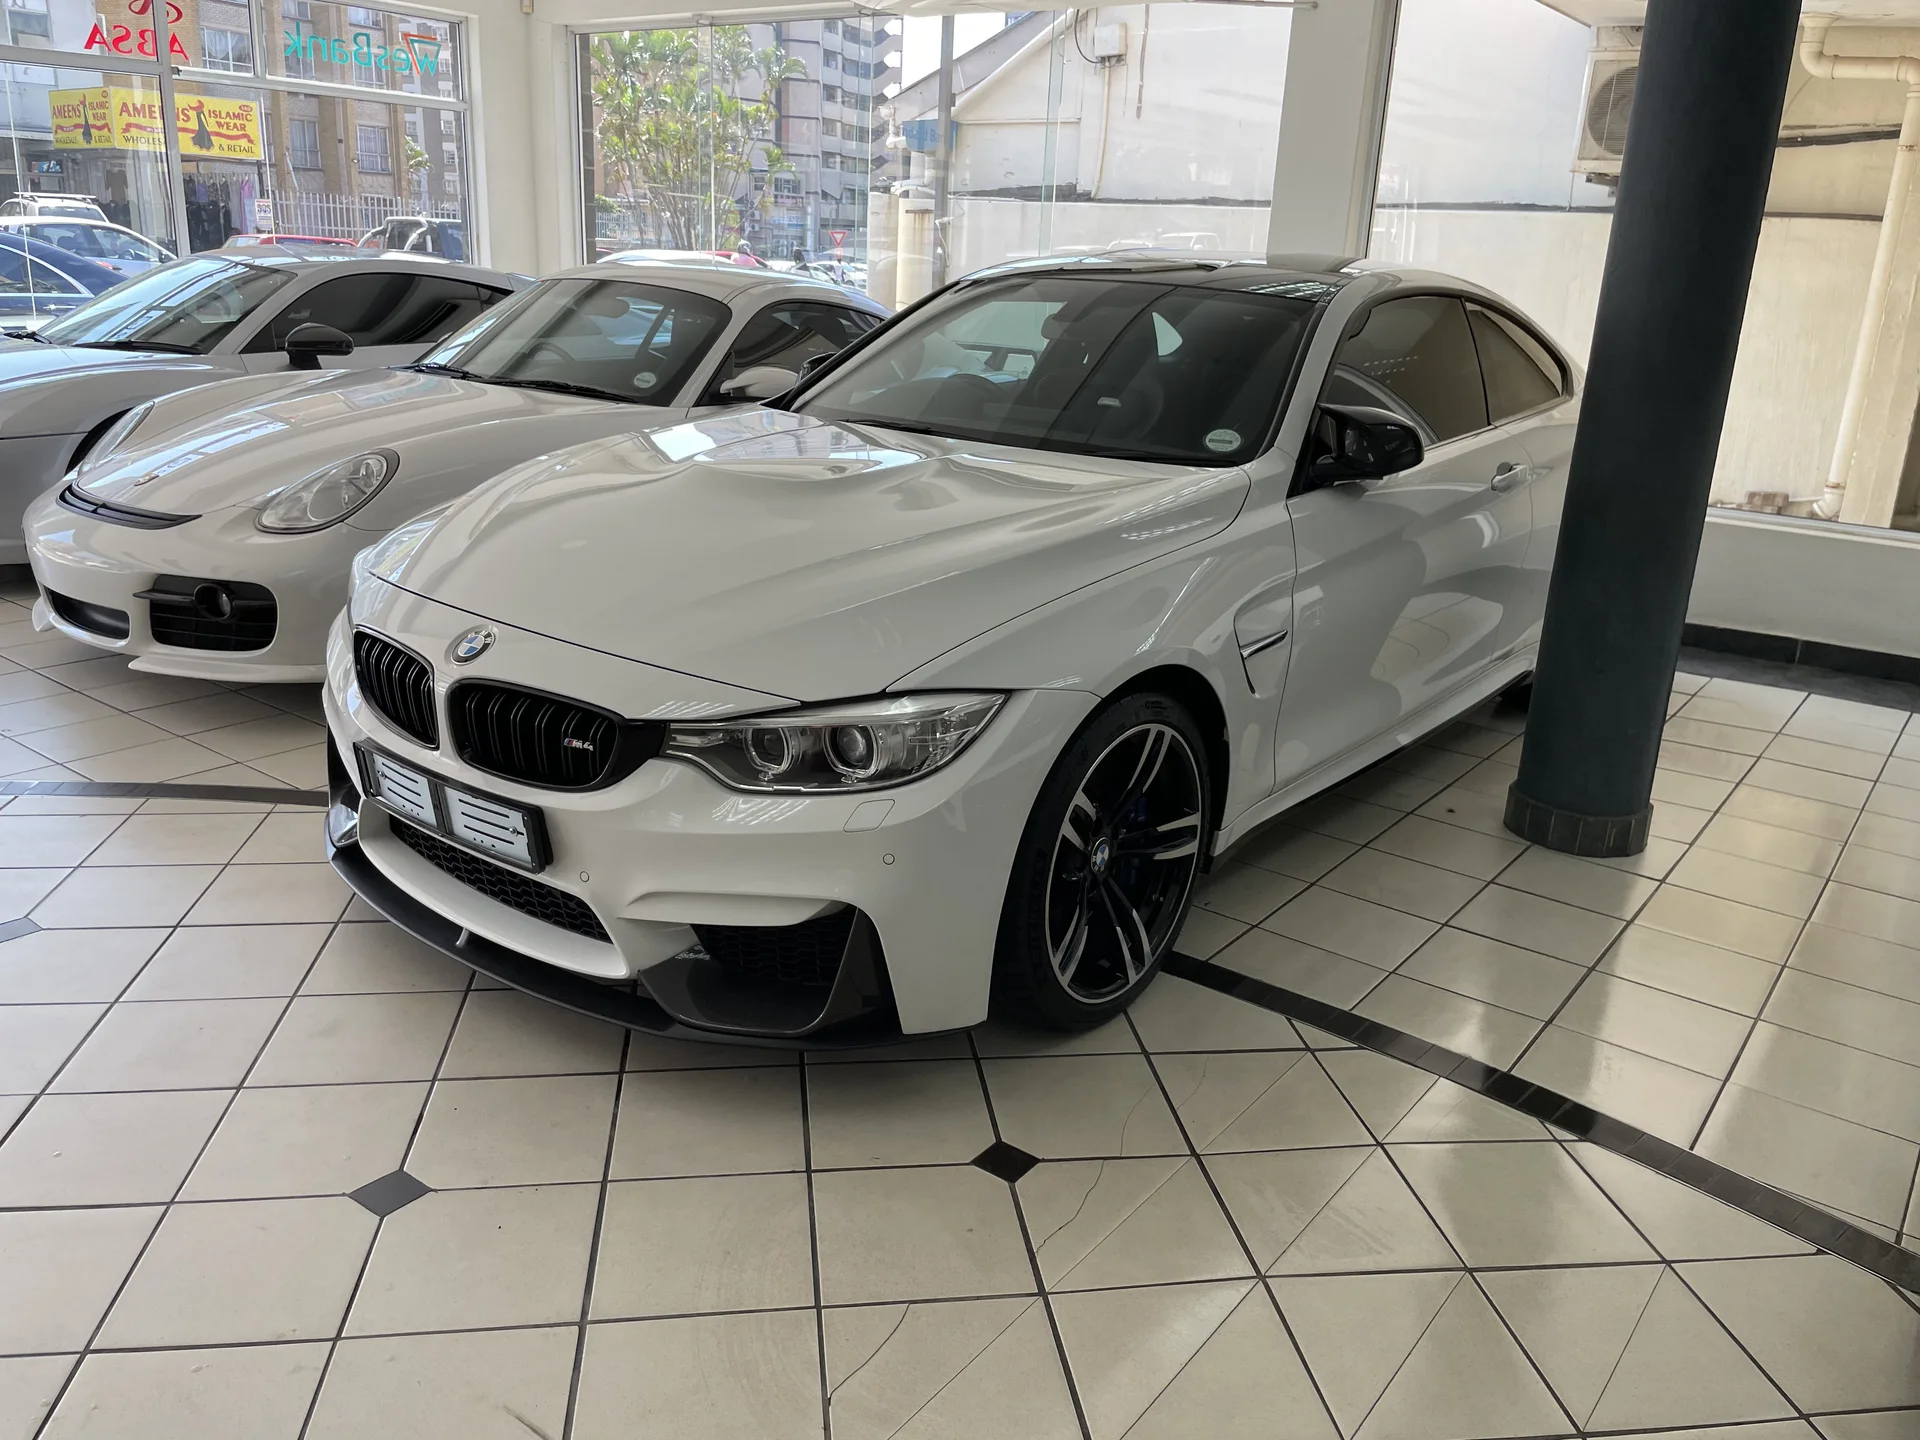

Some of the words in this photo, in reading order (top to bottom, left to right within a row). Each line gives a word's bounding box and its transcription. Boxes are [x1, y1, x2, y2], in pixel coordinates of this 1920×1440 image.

[52, 103, 81, 120] AMEENS
[88, 101, 109, 111] ISLAMIC
[92, 112, 107, 122] WEAR
[208, 109, 253, 122] ISLAMIC
[215, 121, 247, 132] WEAR
[122, 135, 167, 145] WHOLES
[218, 143, 225, 152] &
[227, 143, 255, 154] RETAIL
